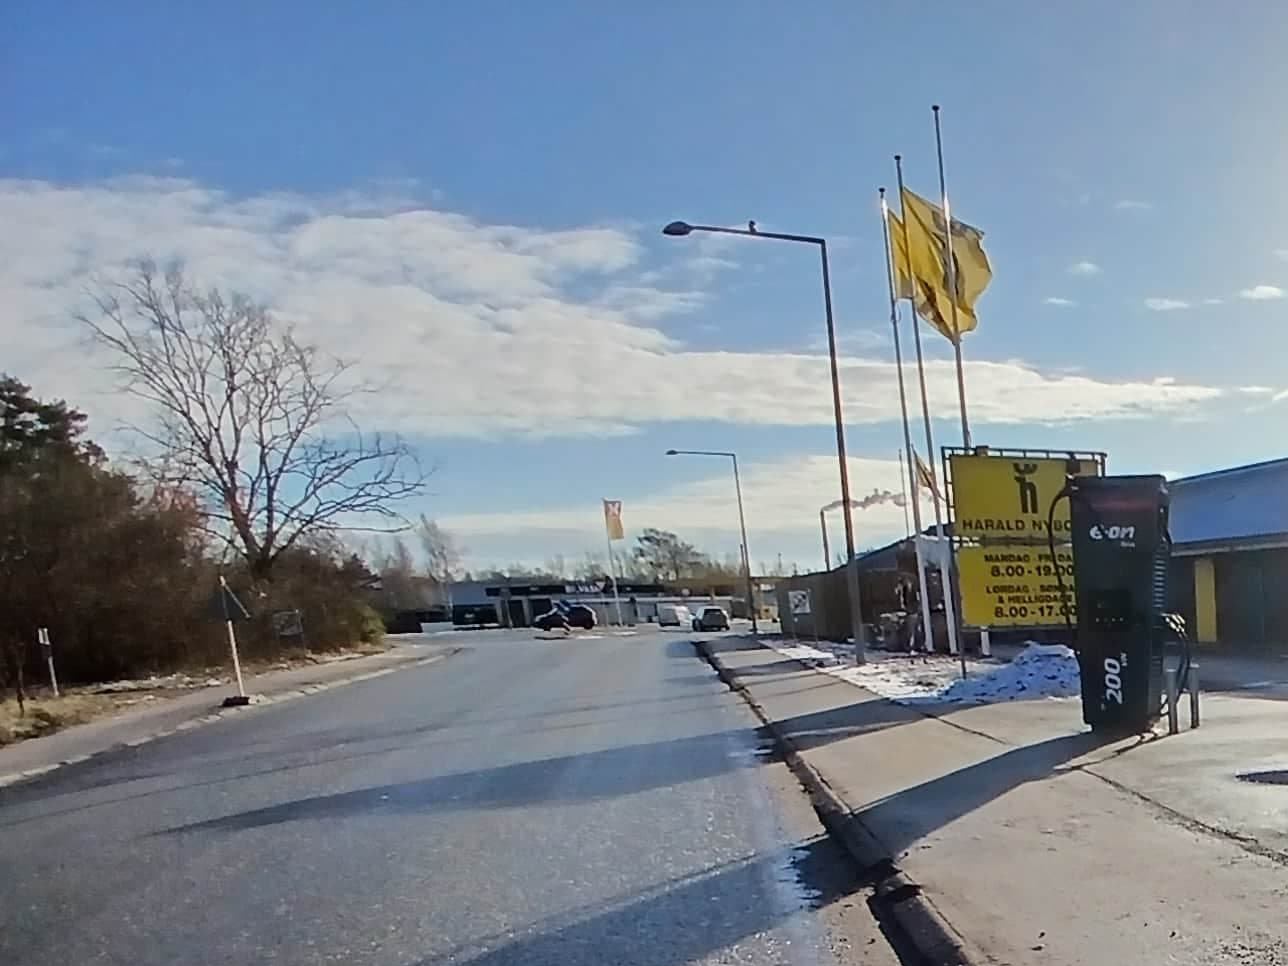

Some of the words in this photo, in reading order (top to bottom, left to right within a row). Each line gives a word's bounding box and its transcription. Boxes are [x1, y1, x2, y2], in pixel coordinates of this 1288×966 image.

[963, 519, 1026, 531] HARALD
[991, 565, 1025, 577] 8.00
[994, 606, 1028, 618] 8.00
[1104, 658, 1122, 704] 200
